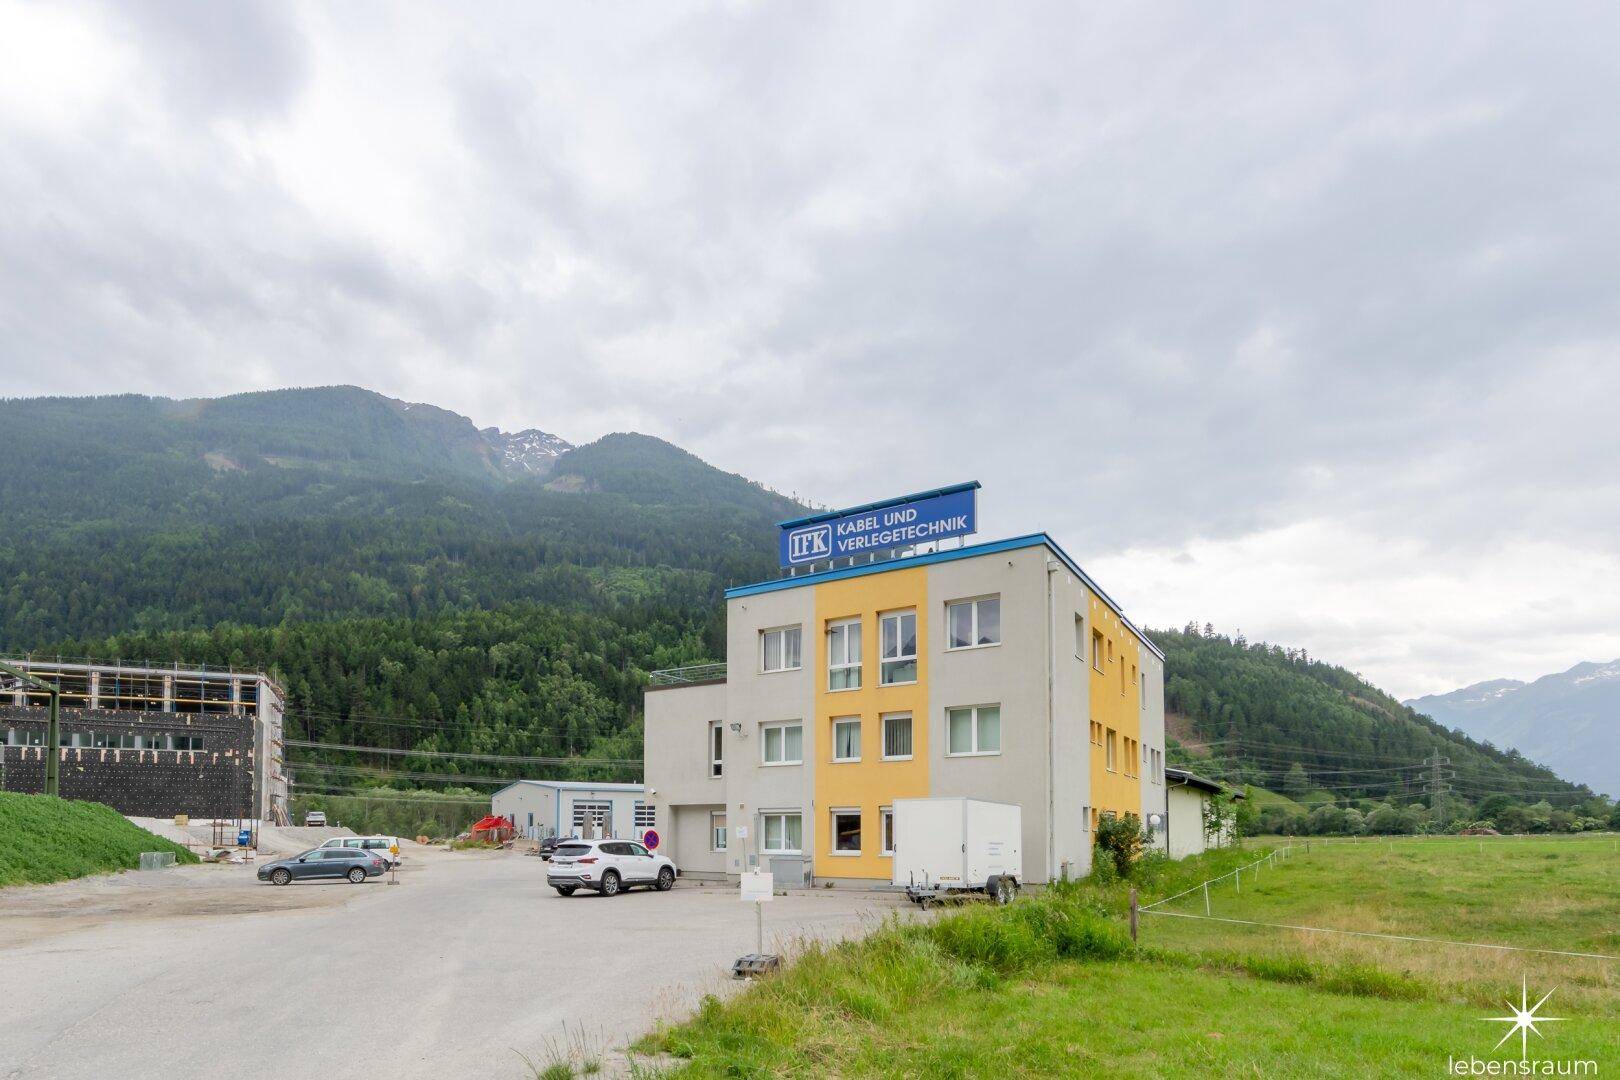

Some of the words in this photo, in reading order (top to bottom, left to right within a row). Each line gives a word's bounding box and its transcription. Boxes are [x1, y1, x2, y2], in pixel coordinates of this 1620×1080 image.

[837, 516, 880, 537] KABEL
[884, 508, 917, 526] UND
[838, 515, 967, 552] VERLEGETECHNIK
[792, 529, 828, 557] IFK
